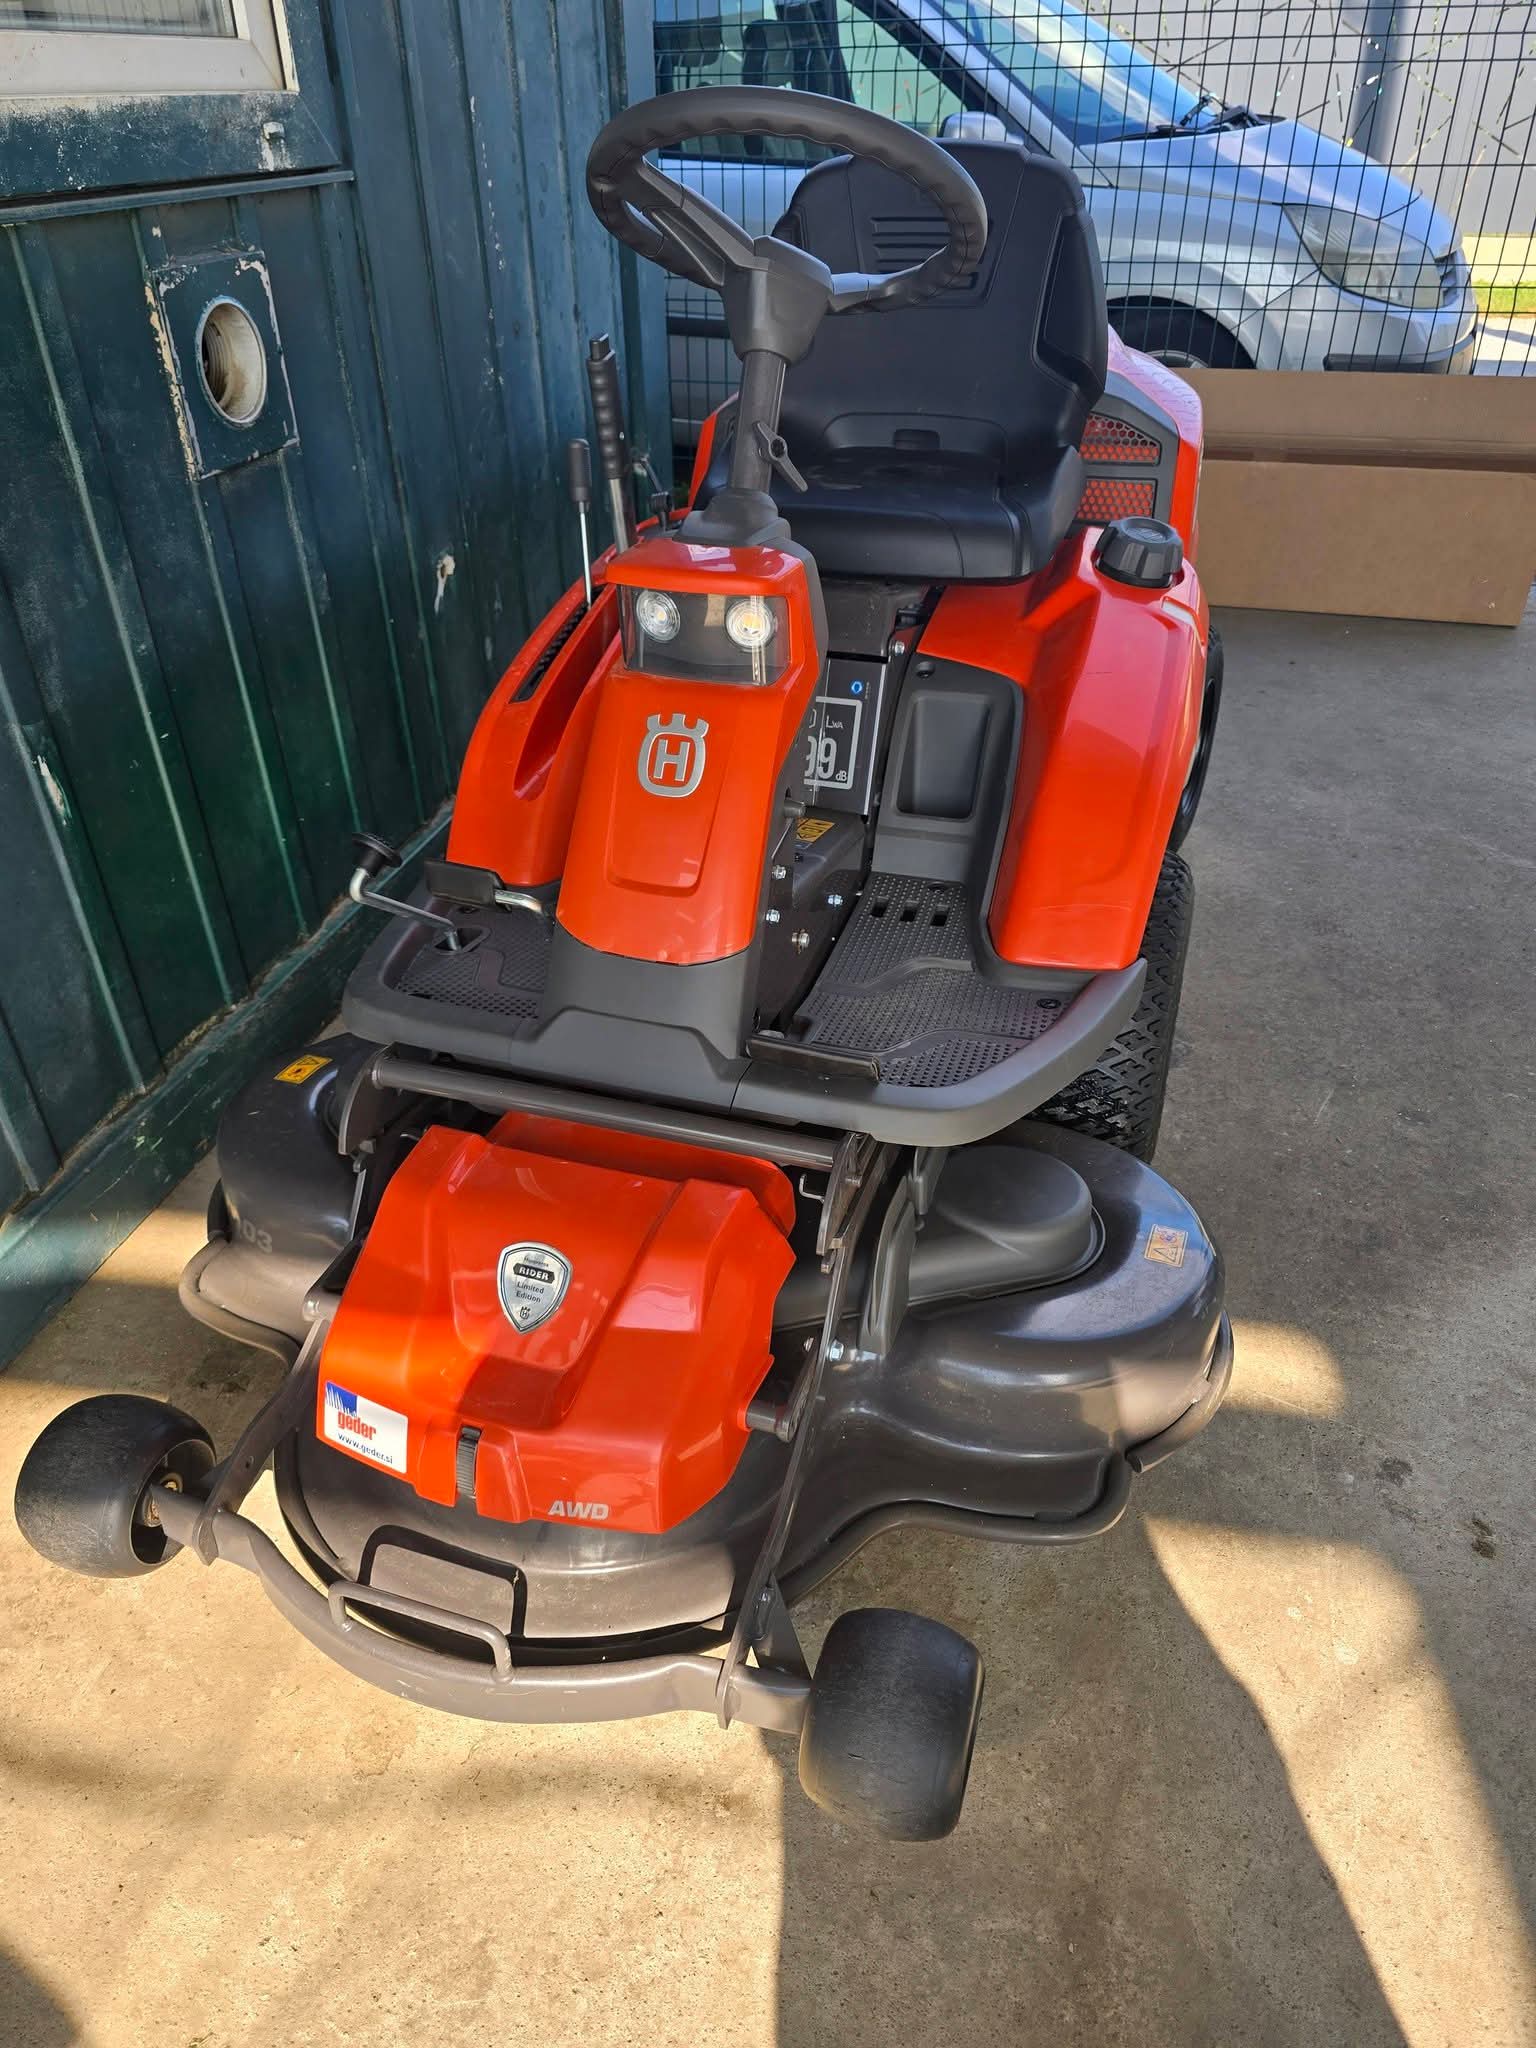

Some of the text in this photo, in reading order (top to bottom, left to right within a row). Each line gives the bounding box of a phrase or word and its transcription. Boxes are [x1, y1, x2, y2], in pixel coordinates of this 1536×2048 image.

[653, 739, 691, 782] H
[835, 770, 847, 782] dB
[240, 1219, 273, 1254] 03
[519, 1266, 549, 1281] RIDER
[516, 1290, 541, 1303] Edition
[517, 1281, 544, 1295] Limited
[338, 1410, 377, 1441] geder
[338, 1432, 393, 1465] www.geder.si
[547, 1500, 609, 1520] AWD
